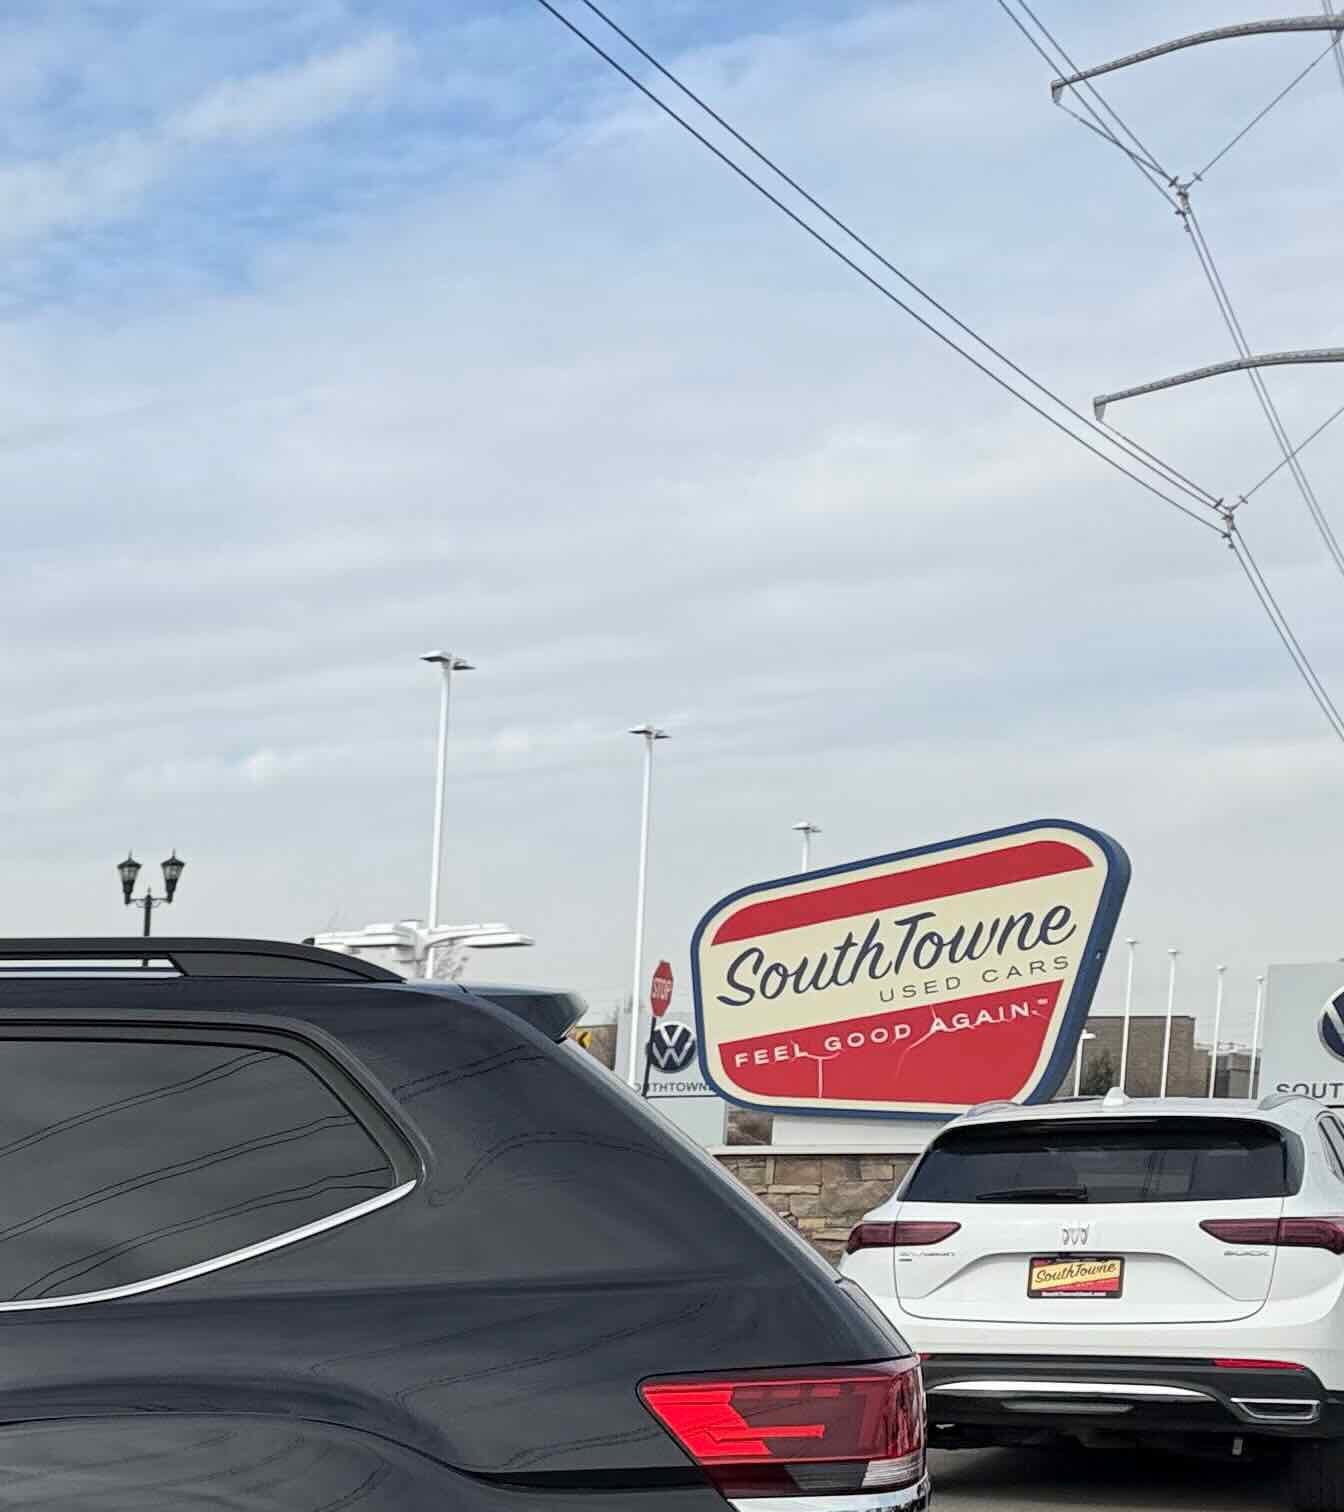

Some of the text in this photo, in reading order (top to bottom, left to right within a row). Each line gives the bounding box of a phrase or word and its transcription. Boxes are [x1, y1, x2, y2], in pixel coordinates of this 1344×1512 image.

[716, 904, 1077, 1007] SouthTowne
[652, 976, 673, 1001] STOP
[879, 955, 1070, 1003] USED CARS
[734, 1041, 809, 1068] FEEL
[825, 1023, 912, 1053] GOOD
[1034, 1262, 1117, 1284] SouthTowne
